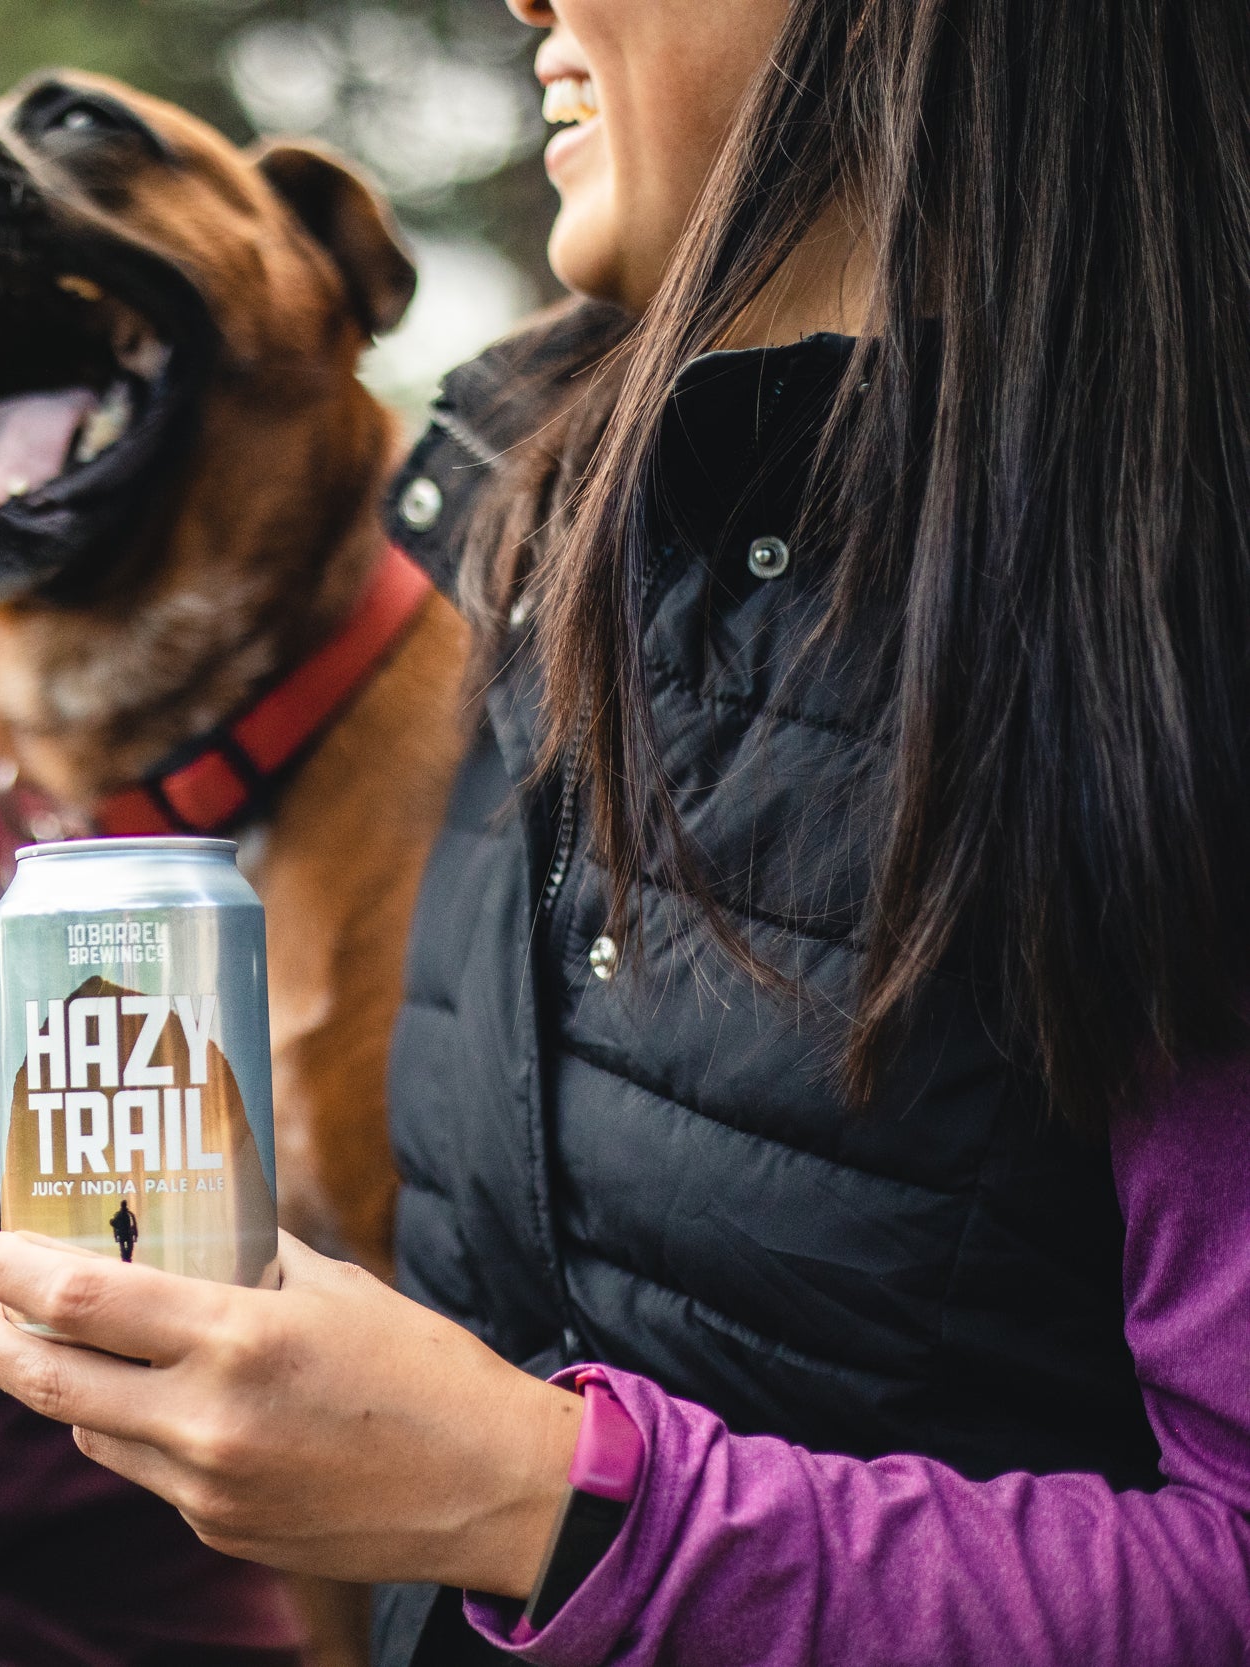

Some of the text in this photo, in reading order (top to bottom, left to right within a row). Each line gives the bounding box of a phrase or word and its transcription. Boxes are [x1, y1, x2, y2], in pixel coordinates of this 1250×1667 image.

[67, 921, 169, 946] 10 BARREL
[68, 945, 144, 966] BREWING
[25, 994, 217, 1090] HAZY
[28, 1087, 223, 1175] TRAIL
[31, 1176, 225, 1197] JUICY INDIA PALE ALE
